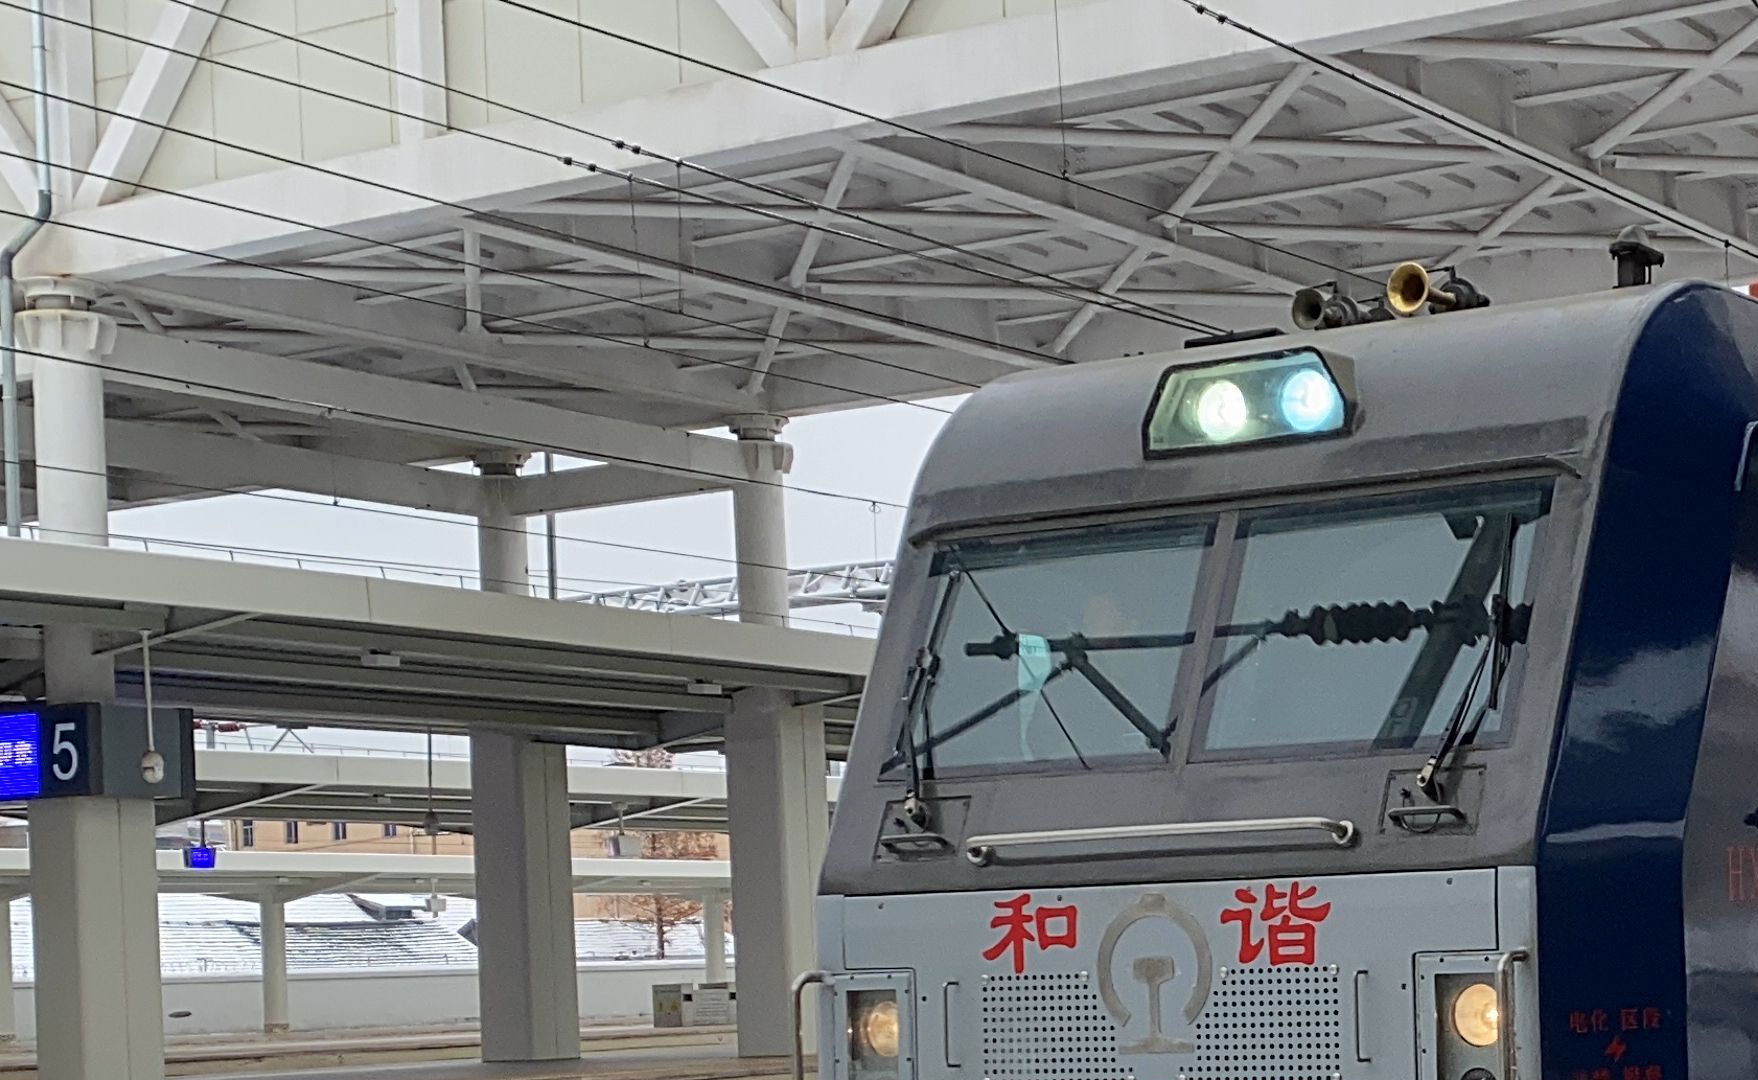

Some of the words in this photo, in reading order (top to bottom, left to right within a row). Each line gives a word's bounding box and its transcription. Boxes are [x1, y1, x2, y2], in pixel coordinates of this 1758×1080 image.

[53, 722, 78, 780] 5
[982, 893, 1078, 974] 和
[1220, 881, 1332, 966] 谐
